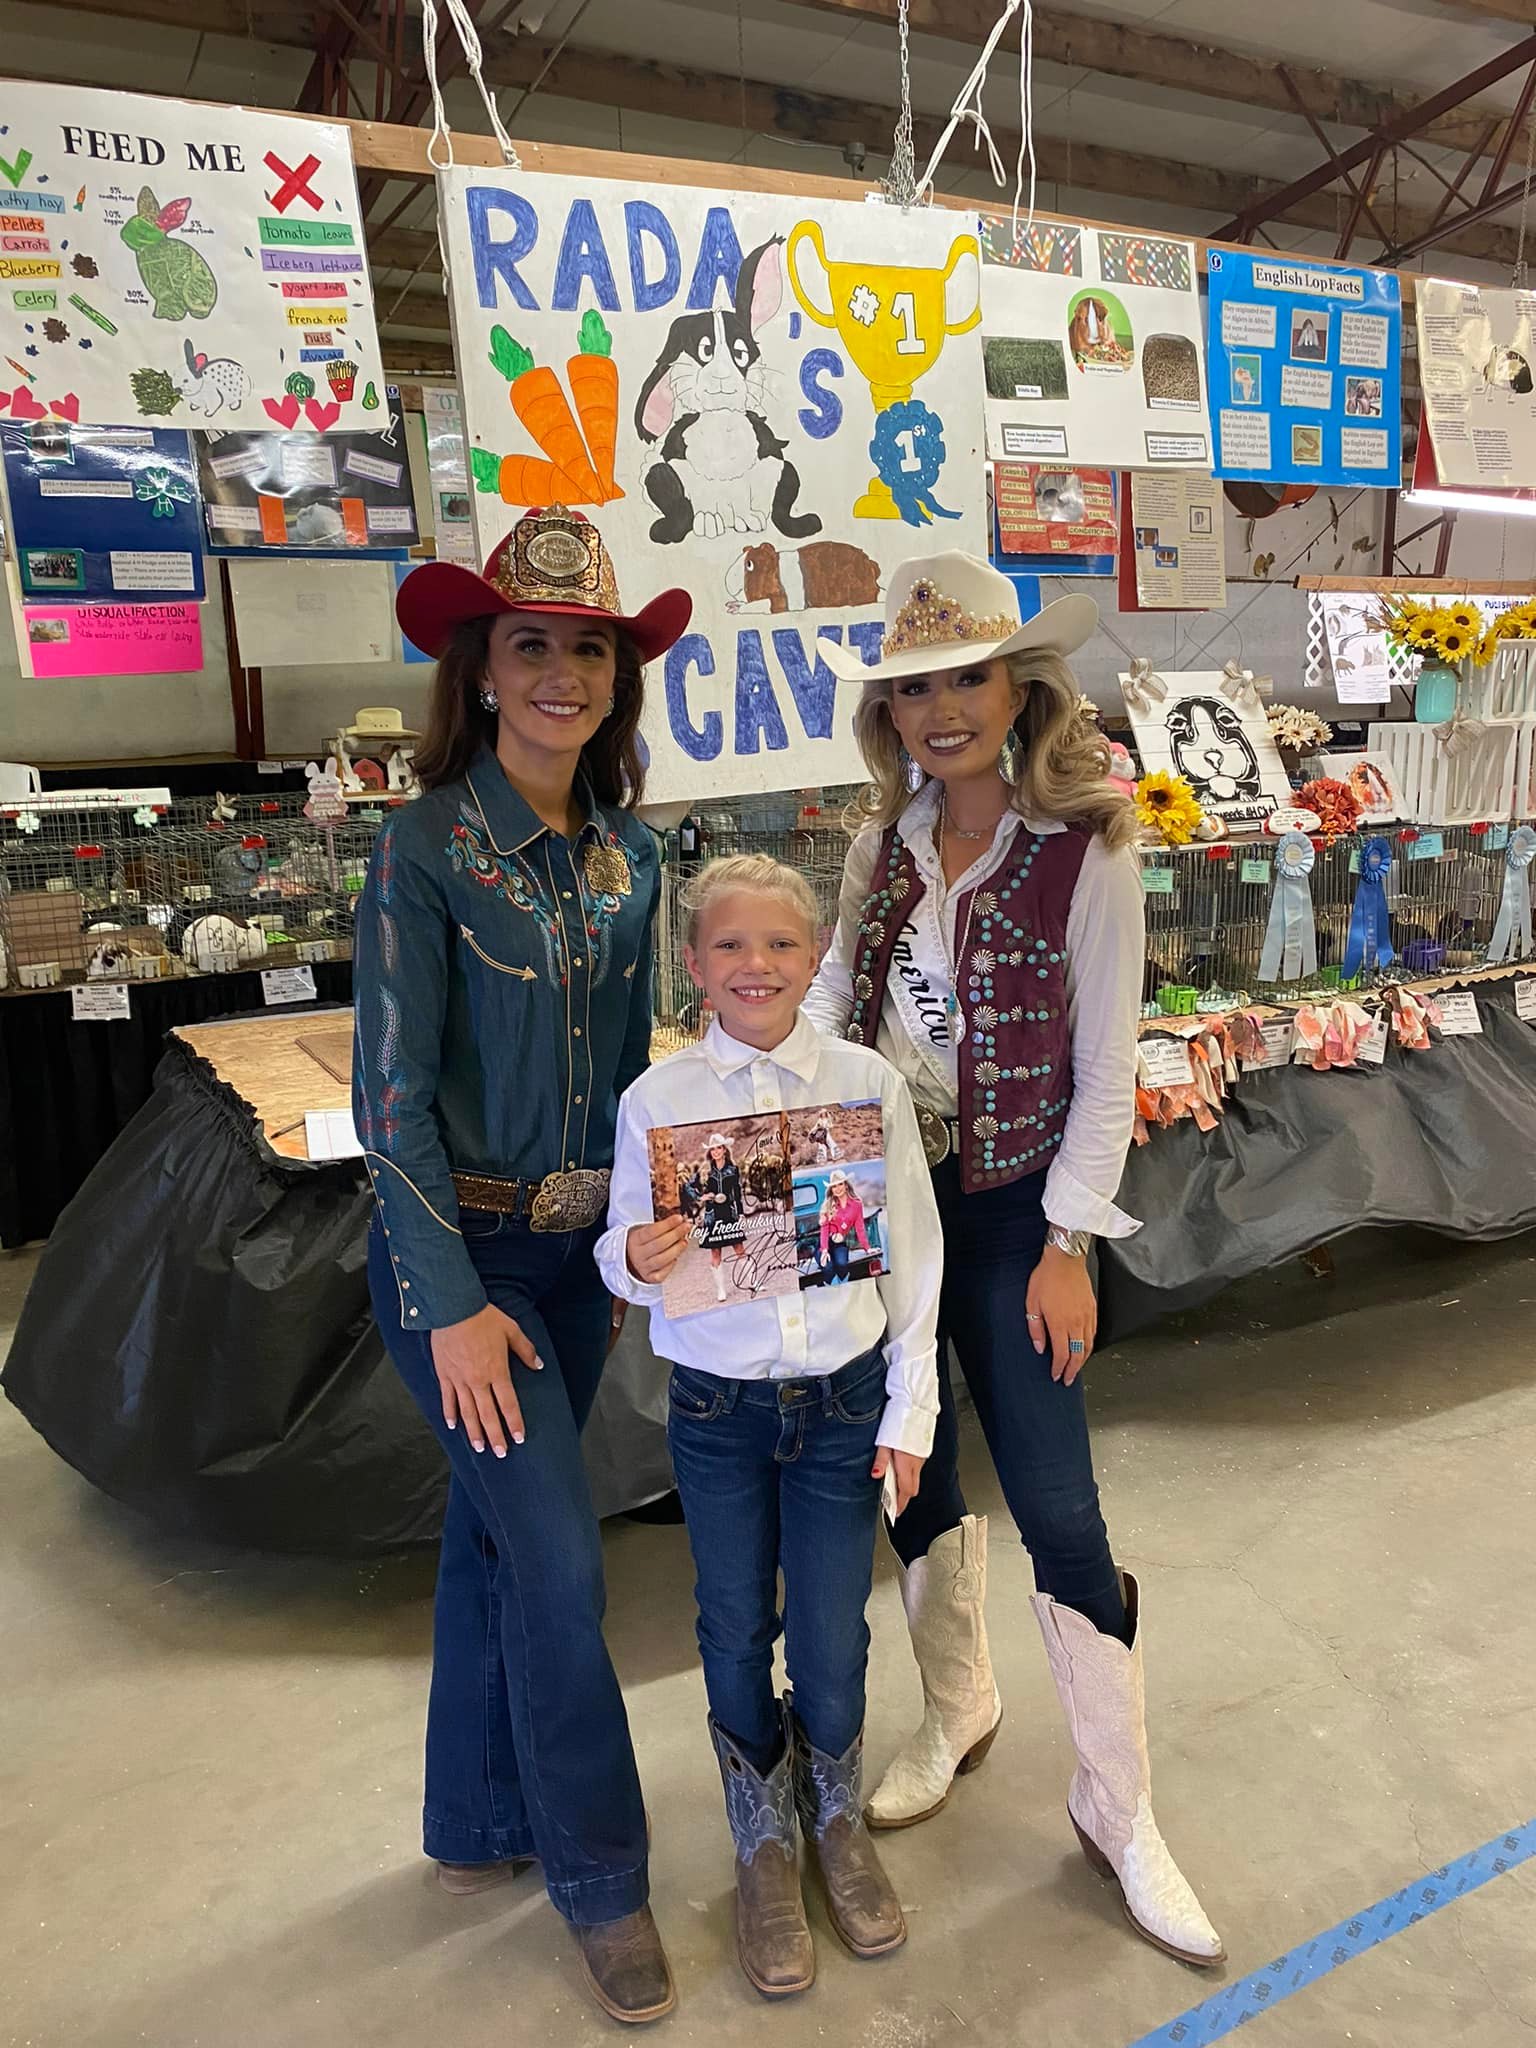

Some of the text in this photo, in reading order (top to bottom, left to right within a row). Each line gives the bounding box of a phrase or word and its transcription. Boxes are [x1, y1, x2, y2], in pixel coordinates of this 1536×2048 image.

[60, 125, 247, 173] FEED ME
[0, 192, 63, 213] othy hay
[2, 216, 45, 232] Pellets
[263, 218, 312, 240] tomato
[3, 236, 49, 251] Carrots
[465, 187, 743, 312] RADA
[0, 260, 62, 279] Blueberry
[265, 253, 361, 273] Iceberg lettuce
[286, 283, 318, 297] yogurt
[1255, 267, 1361, 295] English Lop Facts
[13, 290, 57, 309] Celery
[287, 308, 322, 325] french
[304, 333, 332, 344] nuts
[77, 606, 186, 619] DISQUALIFACTION
[689, 1225, 710, 1245] ley
